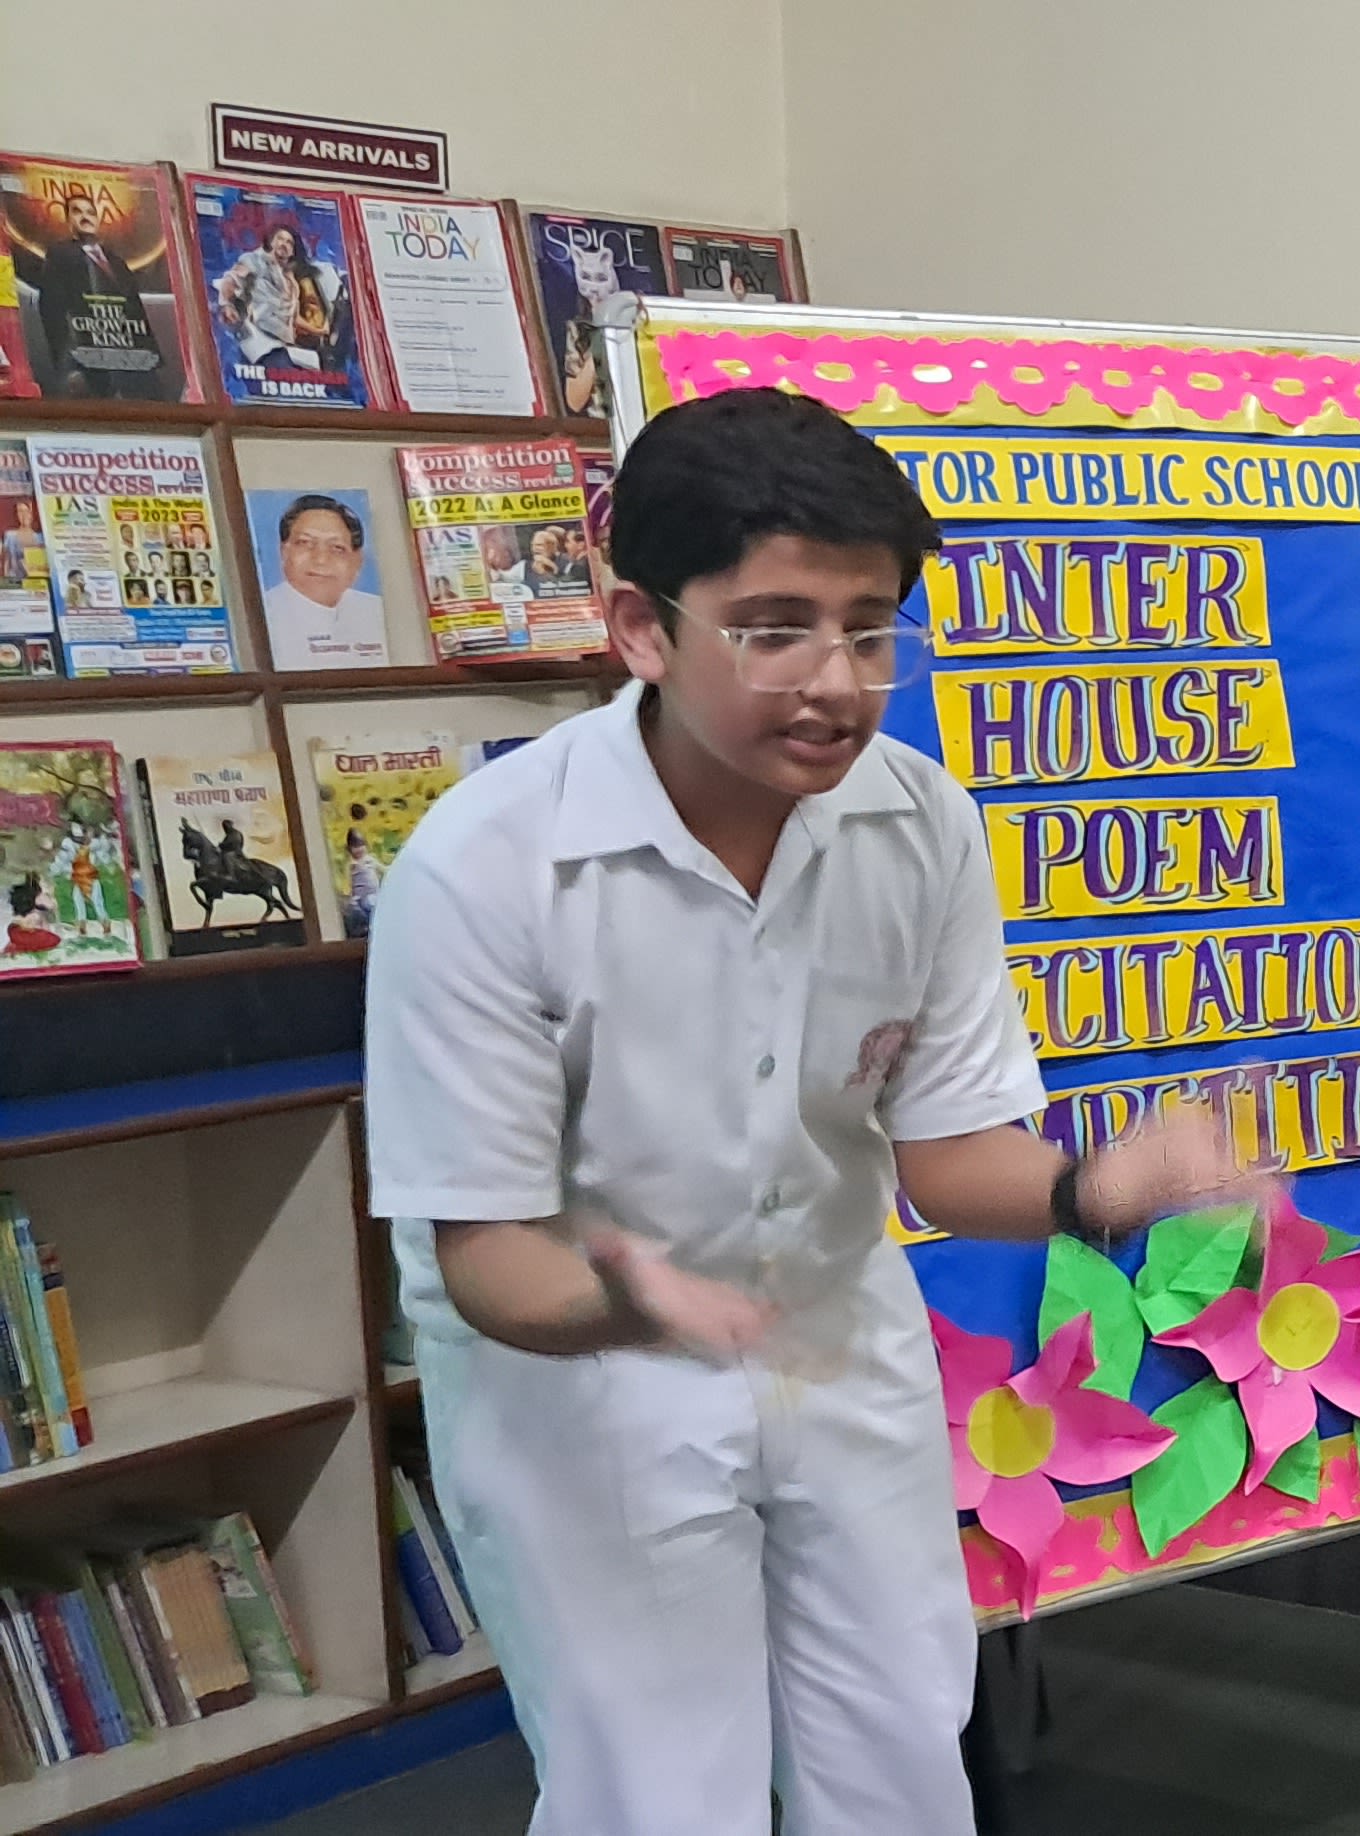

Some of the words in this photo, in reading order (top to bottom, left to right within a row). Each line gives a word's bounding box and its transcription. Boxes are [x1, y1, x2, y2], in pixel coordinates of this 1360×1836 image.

[230, 129, 293, 154] NEW
[300, 138, 431, 171] ARRIVALS
[42, 178, 115, 204] INDIA
[397, 212, 462, 236] INDIA
[385, 230, 480, 262] TODAY
[689, 263, 767, 292] TOAY
[90, 304, 123, 319] THE
[72, 317, 147, 336] GROWTH
[91, 332, 134, 349] KING
[234, 363, 267, 380] THE
[261, 381, 273, 396] IS
[280, 382, 328, 398] BACK
[36, 447, 200, 477] competition
[42, 473, 153, 495] success
[1009, 451, 1189, 507] PUBLIC
[54, 496, 99, 513] IAS
[414, 497, 466, 516] 2022
[501, 496, 515, 511] A
[520, 493, 582, 510] Glance
[426, 528, 473, 545] IAS
[939, 540, 1263, 647] INTER
[961, 666, 1270, 786] HOUSE
[1006, 804, 1279, 916] POEM
